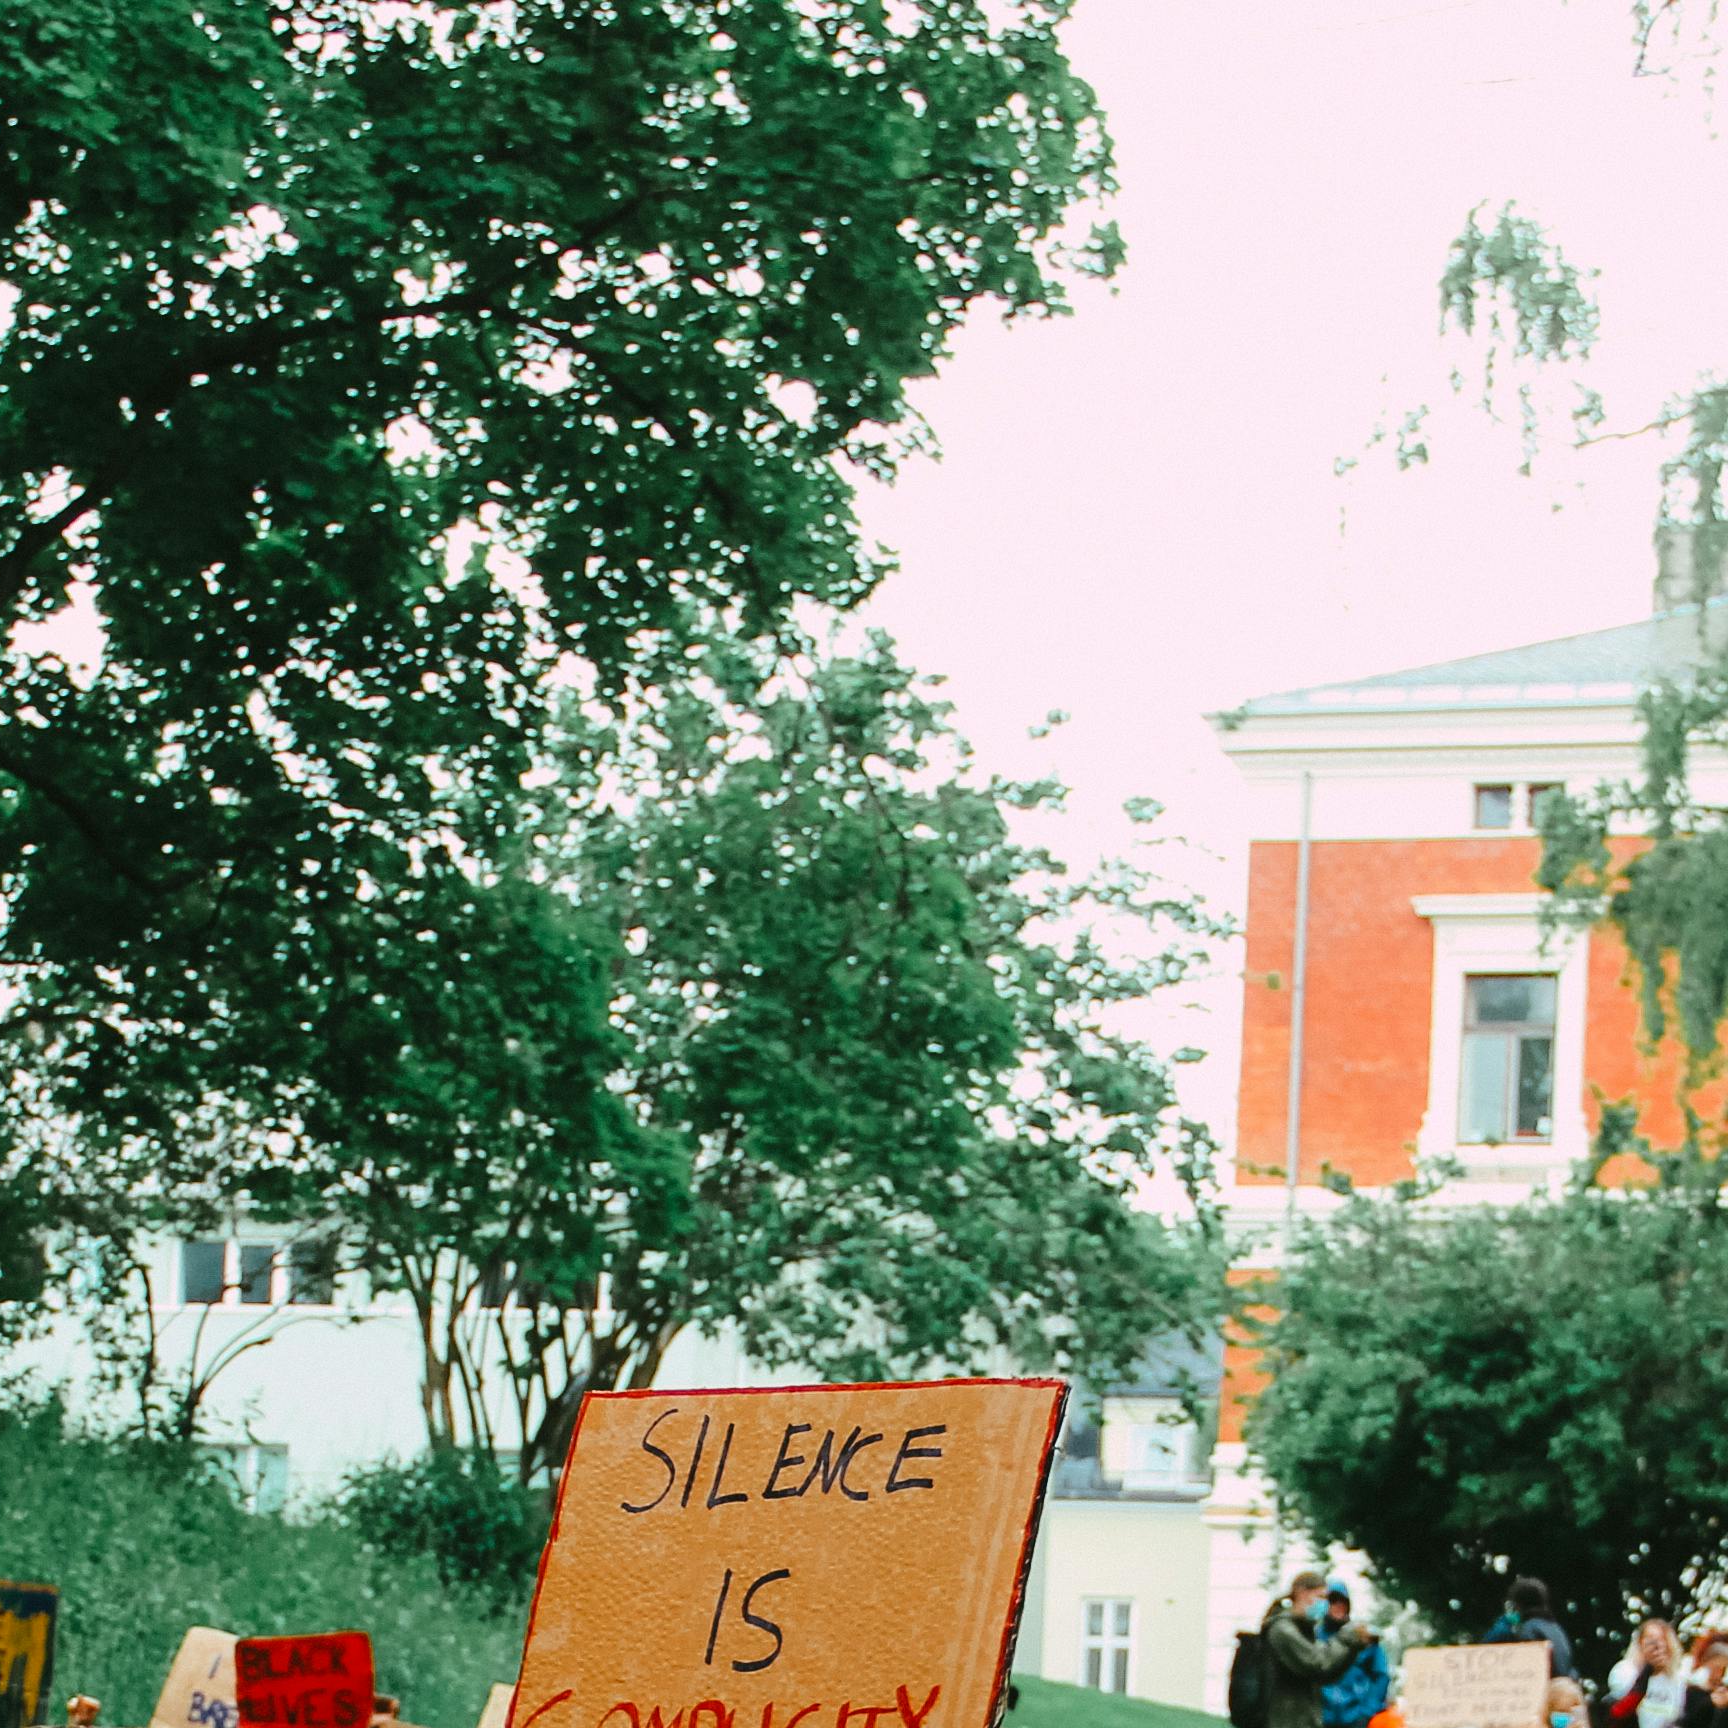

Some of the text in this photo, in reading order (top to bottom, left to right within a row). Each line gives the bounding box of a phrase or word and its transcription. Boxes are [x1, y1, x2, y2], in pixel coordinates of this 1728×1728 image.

[621, 1408, 948, 1514] SILENCE
[705, 1568, 792, 1672] IS
[241, 1646, 348, 1684] BLACK
[239, 1688, 360, 1727] LIVES
